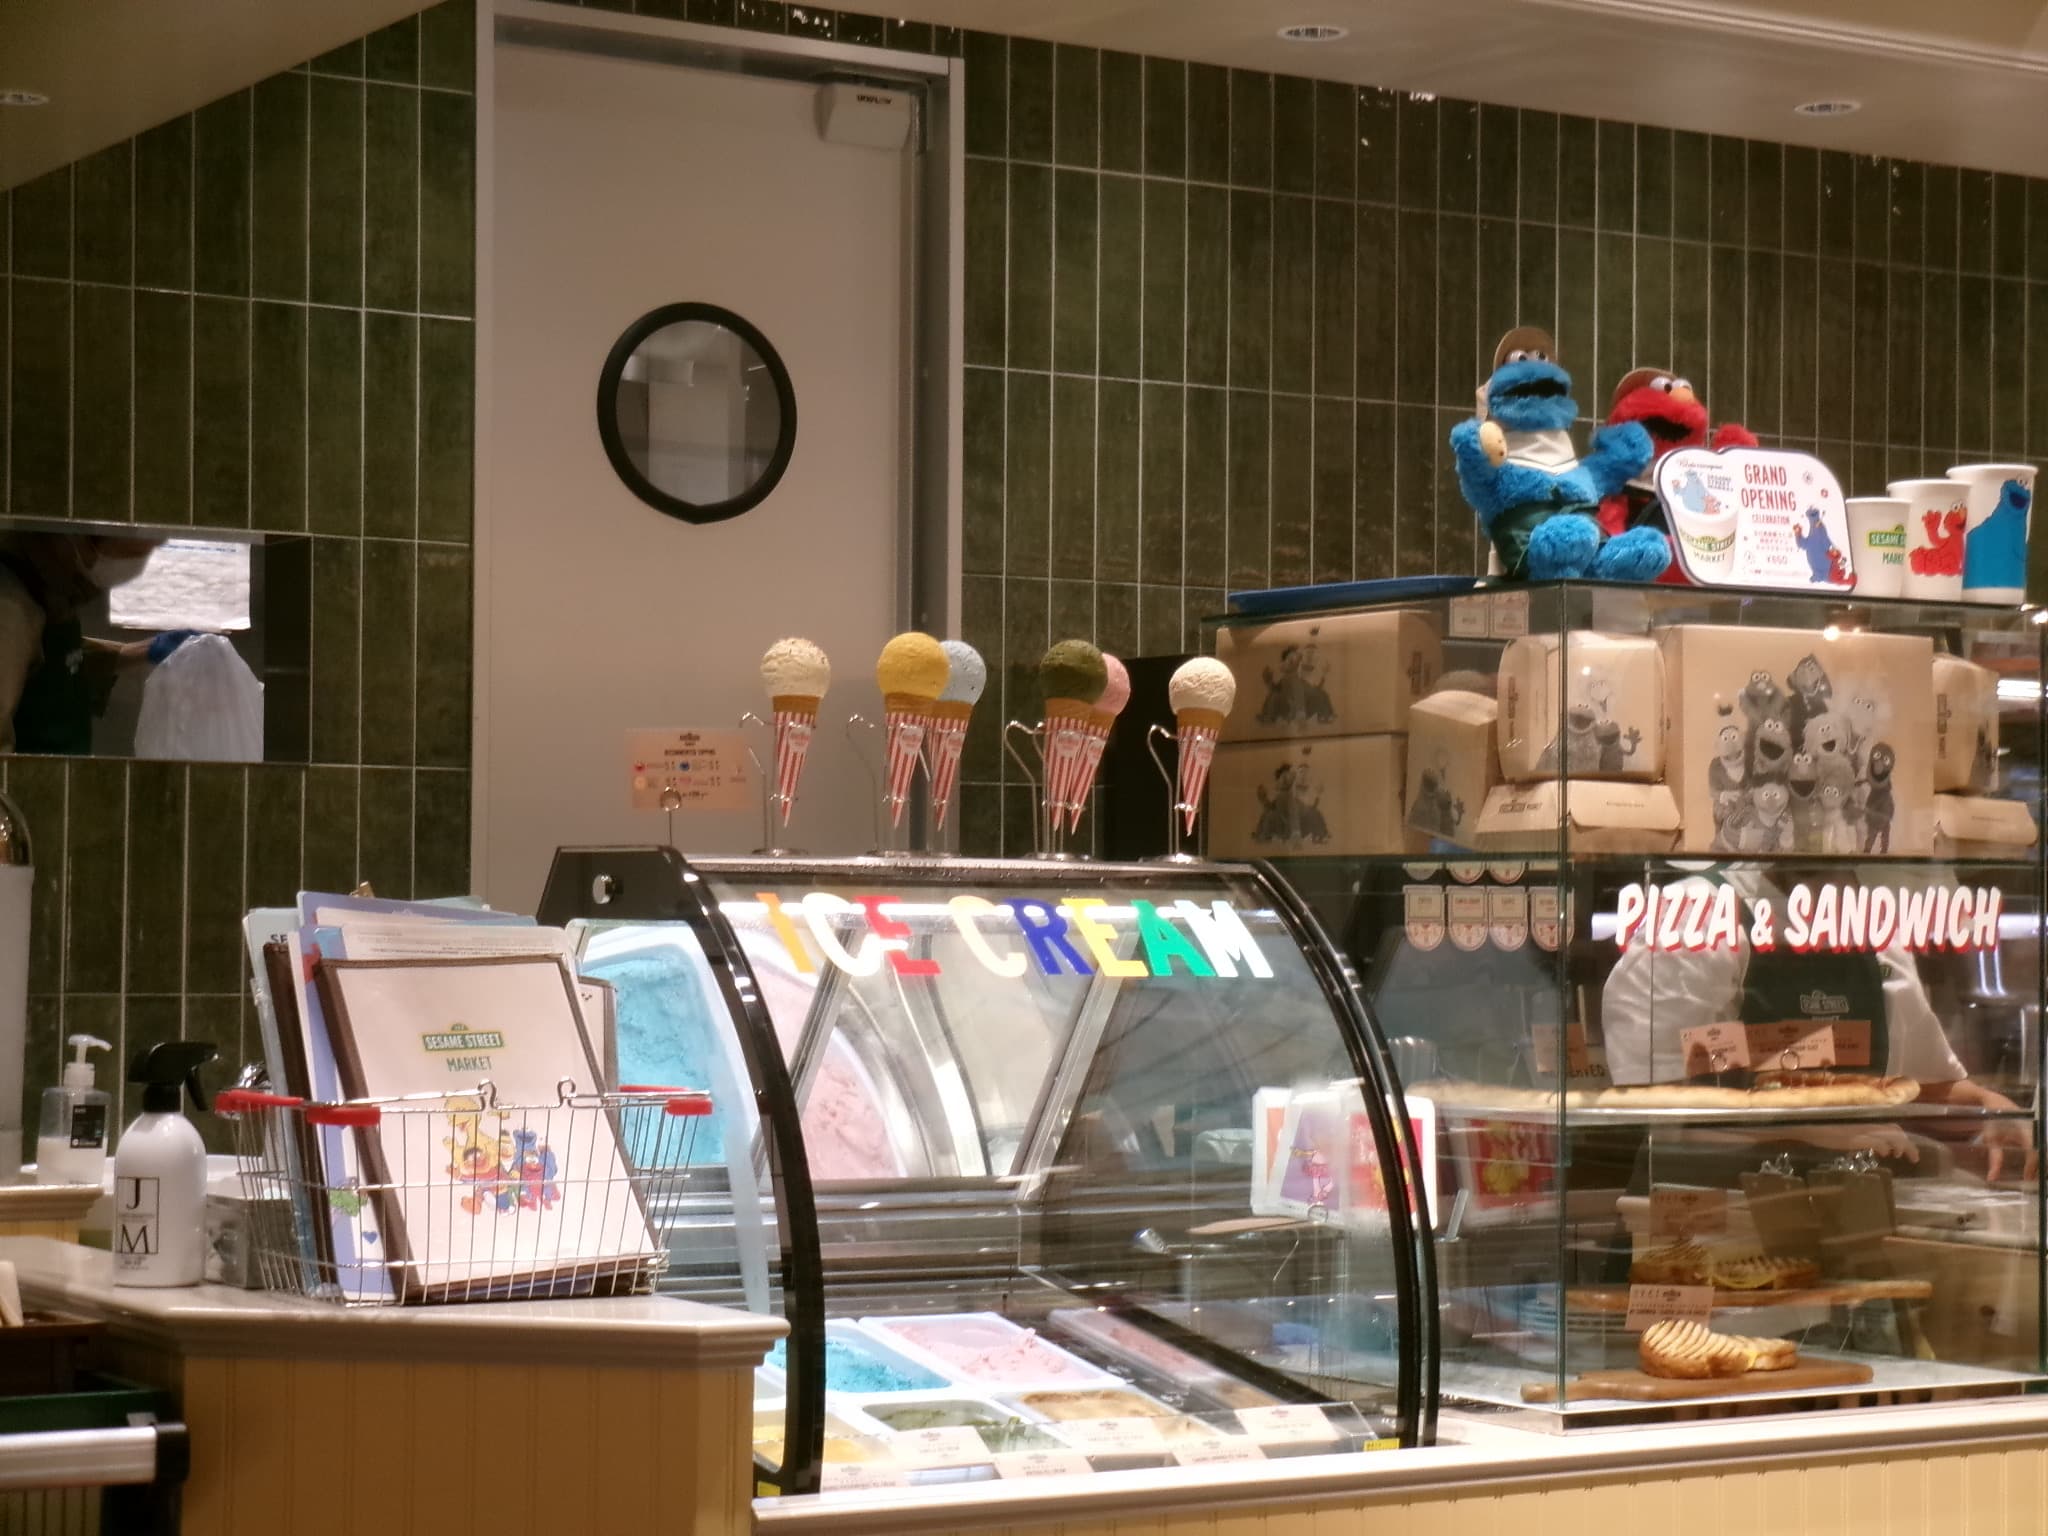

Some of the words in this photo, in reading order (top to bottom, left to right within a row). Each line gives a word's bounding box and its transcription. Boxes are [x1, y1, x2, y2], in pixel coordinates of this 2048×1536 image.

[1744, 463, 1787, 486] GRAND
[1741, 488, 1796, 511] OPENING
[1615, 883, 1742, 952] PIZZA
[1751, 898, 1775, 953] &
[1784, 883, 2003, 953] SANDWICH
[756, 892, 941, 976] ICE
[948, 895, 1274, 977] CREAM
[425, 1034, 464, 1049] SESAME
[465, 1032, 501, 1048] STREET
[446, 1056, 492, 1072] MARKET
[120, 1224, 149, 1254] M
